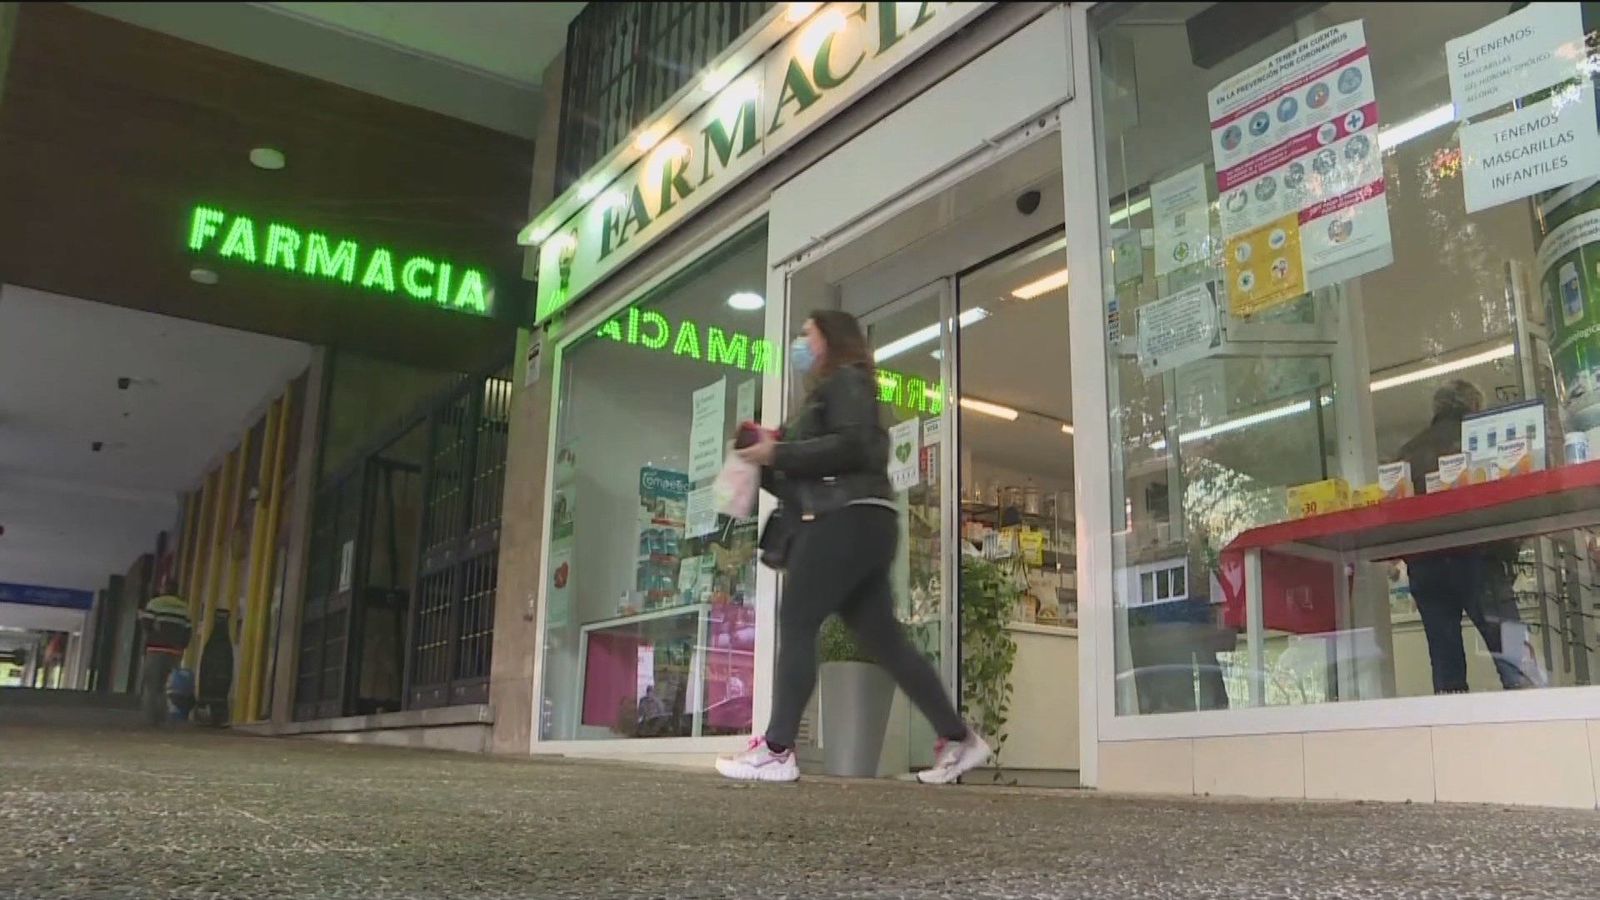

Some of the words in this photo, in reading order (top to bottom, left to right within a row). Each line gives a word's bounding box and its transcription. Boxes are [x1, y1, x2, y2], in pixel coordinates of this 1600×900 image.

[1236, 69, 1278, 96] PREVENCIÓN
[1280, 60, 1294, 71] POR
[1296, 33, 1348, 65] CORONAVIRUS
[1275, 49, 1297, 64] TENER
[1310, 27, 1339, 46] CUENTA
[1493, 113, 1559, 143] TENEMOS
[1482, 130, 1575, 170] MASCARILLAS
[1491, 155, 1568, 189] INFANTILES
[189, 206, 487, 313] FARMACIA
